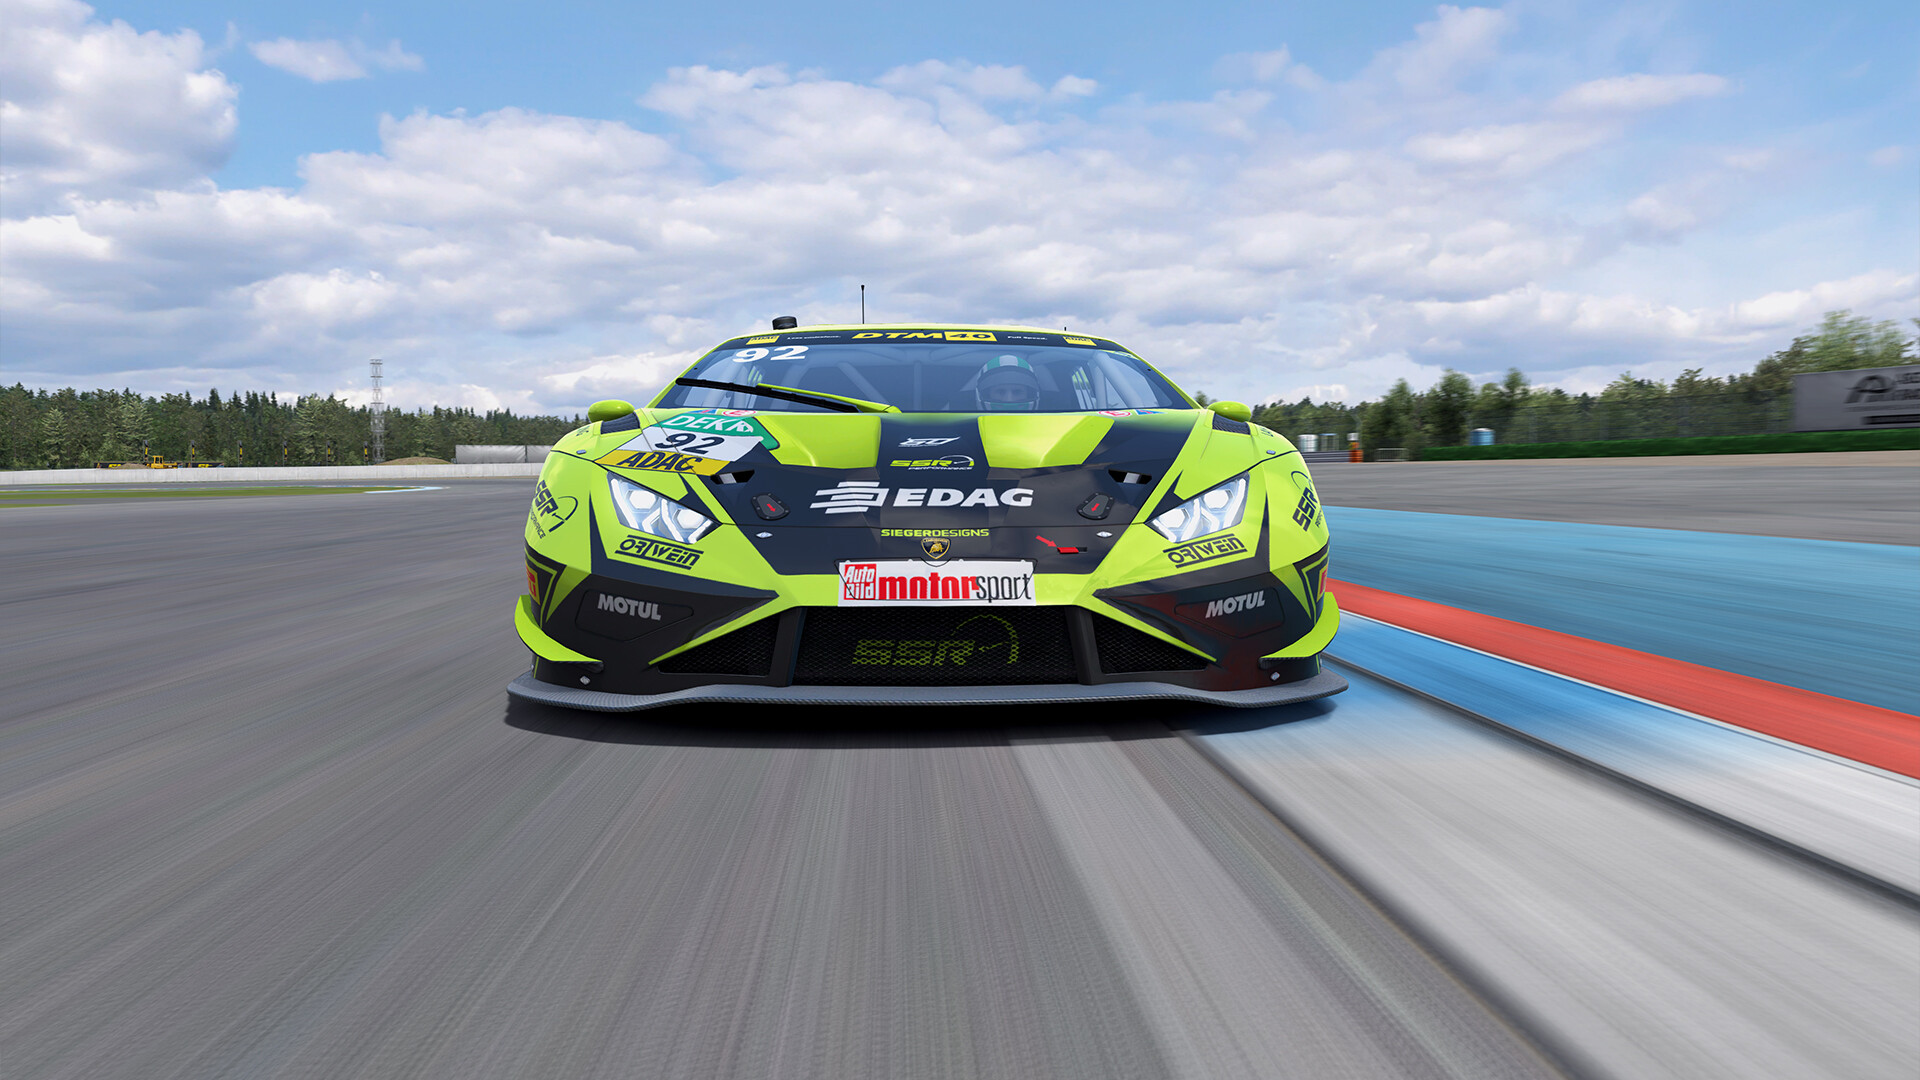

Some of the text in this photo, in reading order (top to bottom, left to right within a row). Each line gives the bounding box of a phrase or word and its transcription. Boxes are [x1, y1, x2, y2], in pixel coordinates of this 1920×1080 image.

[732, 345, 809, 363] 92
[654, 432, 725, 455] 92
[616, 451, 703, 472] ADAC
[534, 480, 559, 517] SSR
[893, 488, 1034, 507] EDAG
[1292, 486, 1318, 532] SSR
[880, 529, 990, 537] SIEGERDESIGNS
[846, 566, 875, 583] Auto
[846, 583, 874, 599] Bild
[878, 572, 1032, 603] motorsport
[598, 593, 661, 621] MOTUL
[1205, 590, 1265, 619] MOTUL
[852, 639, 976, 666] SSR
